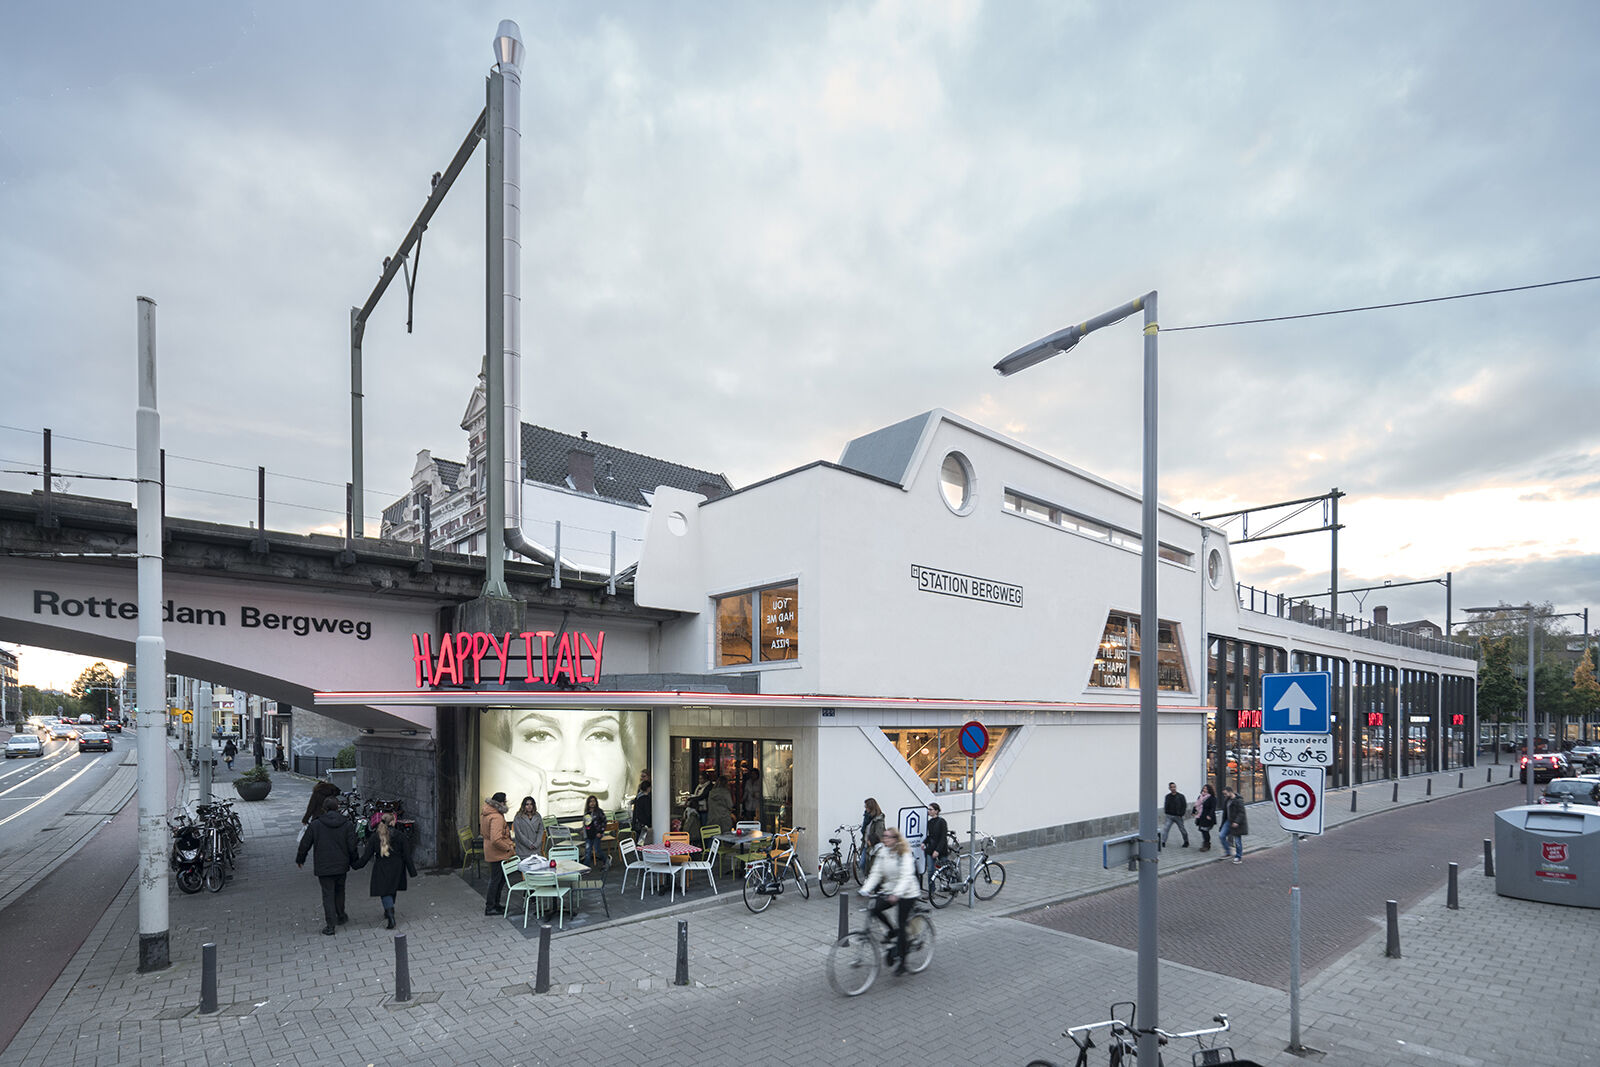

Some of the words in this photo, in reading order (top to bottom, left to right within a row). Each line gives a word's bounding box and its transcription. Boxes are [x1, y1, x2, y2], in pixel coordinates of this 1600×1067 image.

[920, 571, 968, 594] STATION
[971, 581, 1022, 603] BERGWEG
[33, 590, 226, 626] Rottedam
[240, 606, 372, 640] Bergweg
[411, 632, 511, 688] HAPPY
[520, 631, 605, 685] ITALY
[1106, 662, 1127, 673] HAPPY
[1264, 737, 1328, 745] uitgezonderd
[1282, 769, 1307, 777] ZONE
[1279, 792, 1308, 808] 30
[909, 817, 917, 834] P
